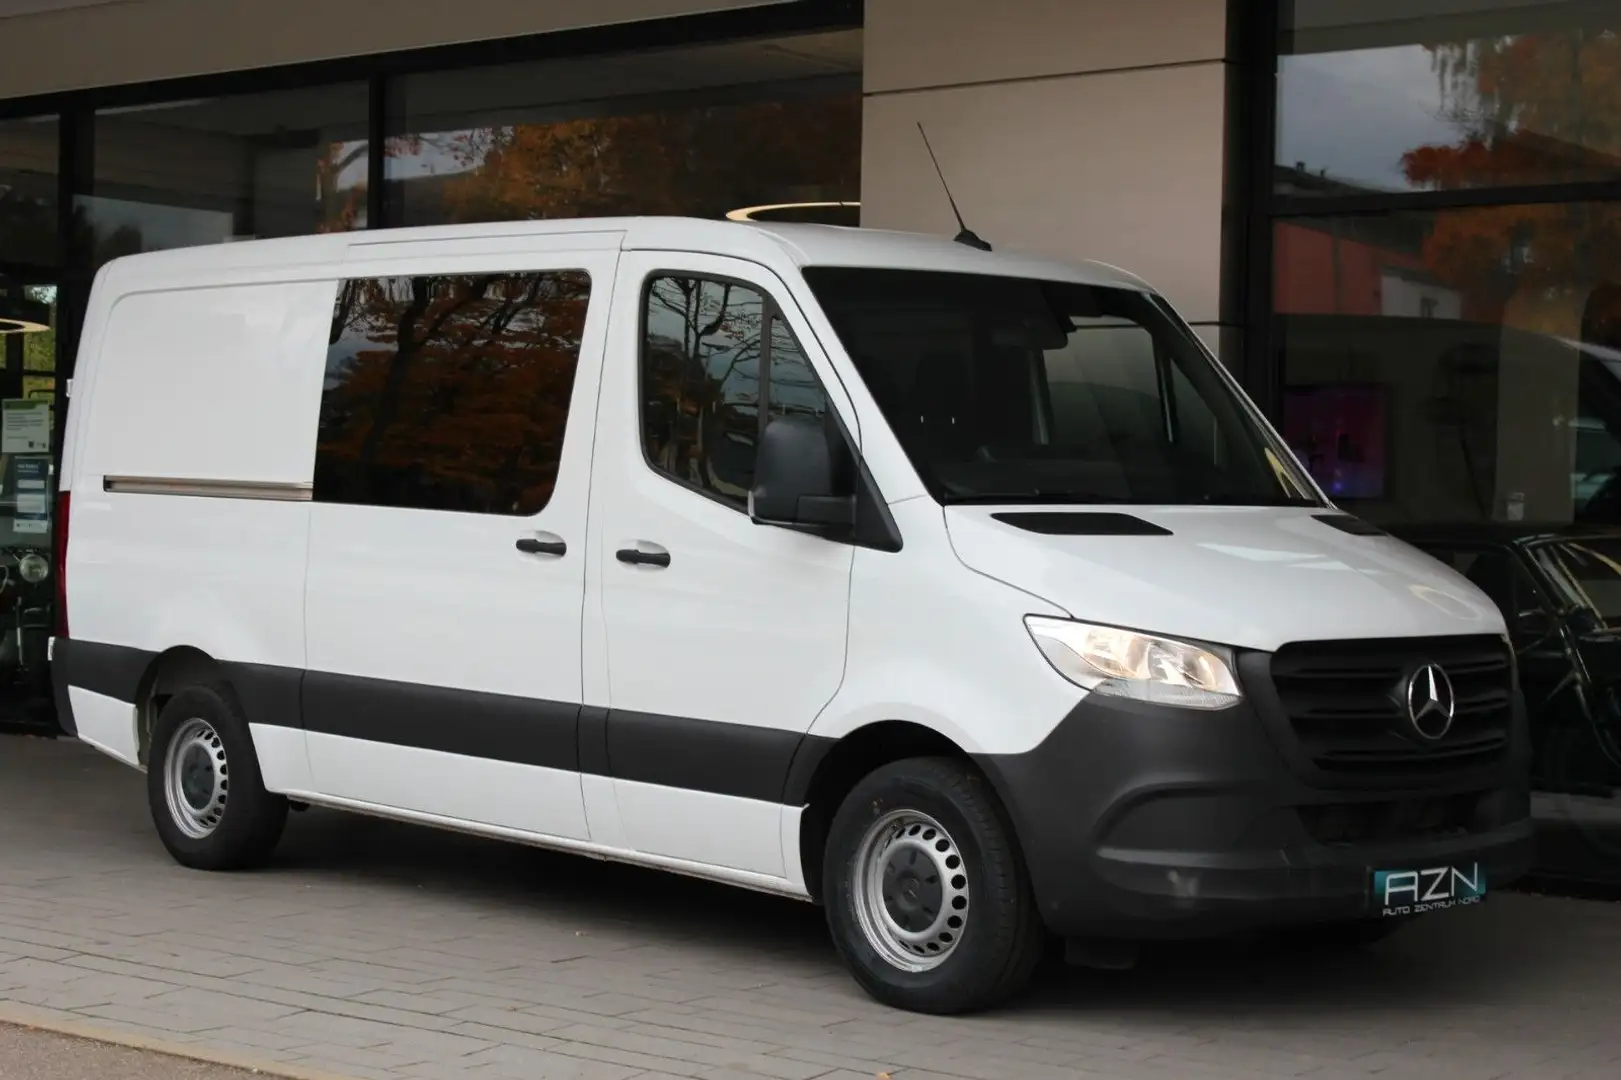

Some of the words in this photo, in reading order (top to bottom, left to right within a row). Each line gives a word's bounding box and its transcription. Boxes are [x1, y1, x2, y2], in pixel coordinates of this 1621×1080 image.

[1384, 862, 1478, 906] AZN
[1382, 905, 1411, 916] AUTO
[1414, 899, 1456, 913] ZENTRUM
[1458, 895, 1481, 905] NORD
